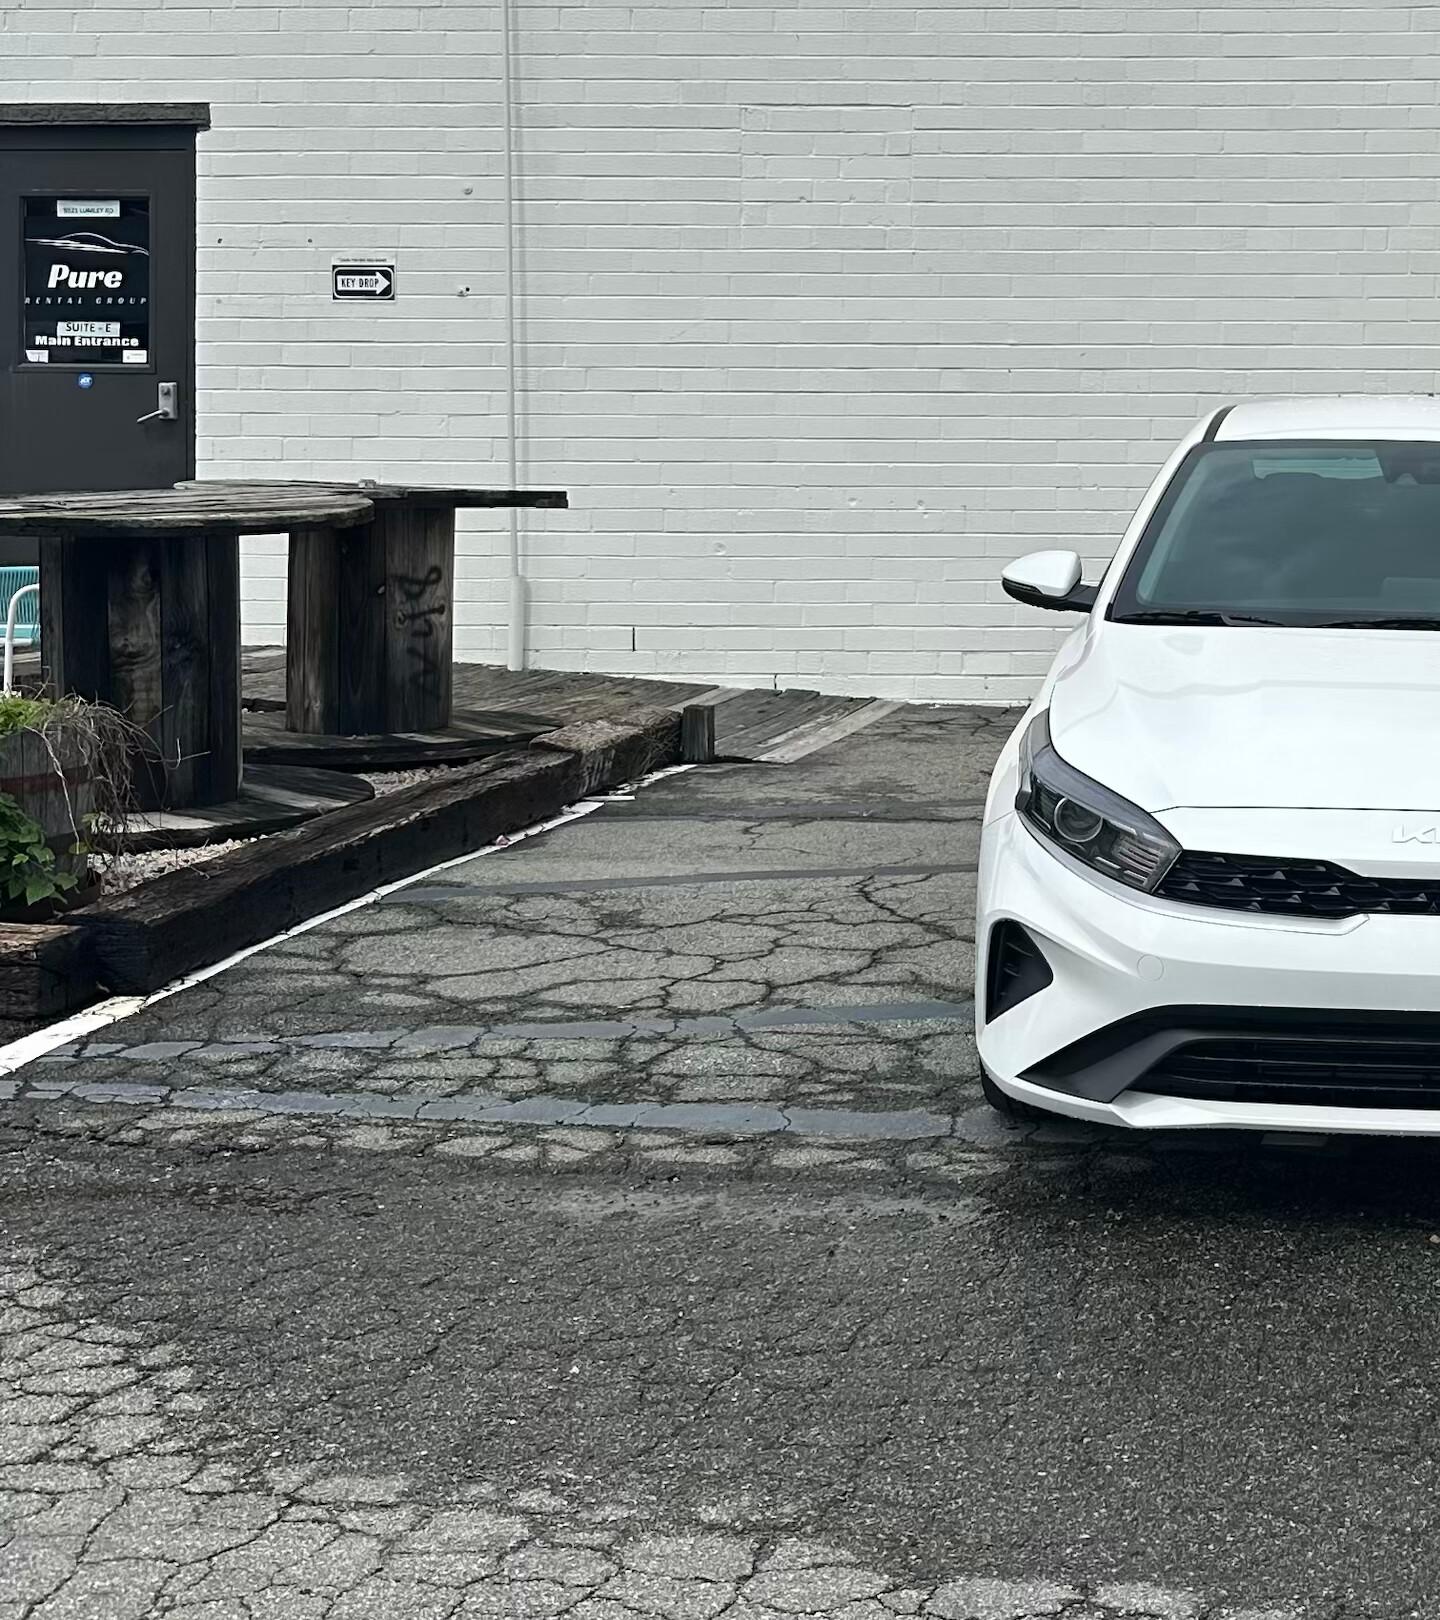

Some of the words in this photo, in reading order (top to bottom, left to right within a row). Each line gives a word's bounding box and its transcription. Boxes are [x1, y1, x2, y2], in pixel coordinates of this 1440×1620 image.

[47, 264, 123, 288] Pure
[341, 278, 356, 288] KEY
[359, 278, 379, 288] DROP
[66, 322, 95, 332] SUITE
[105, 323, 111, 332] E
[35, 335, 71, 346] Main
[74, 336, 139, 347] Entrance
